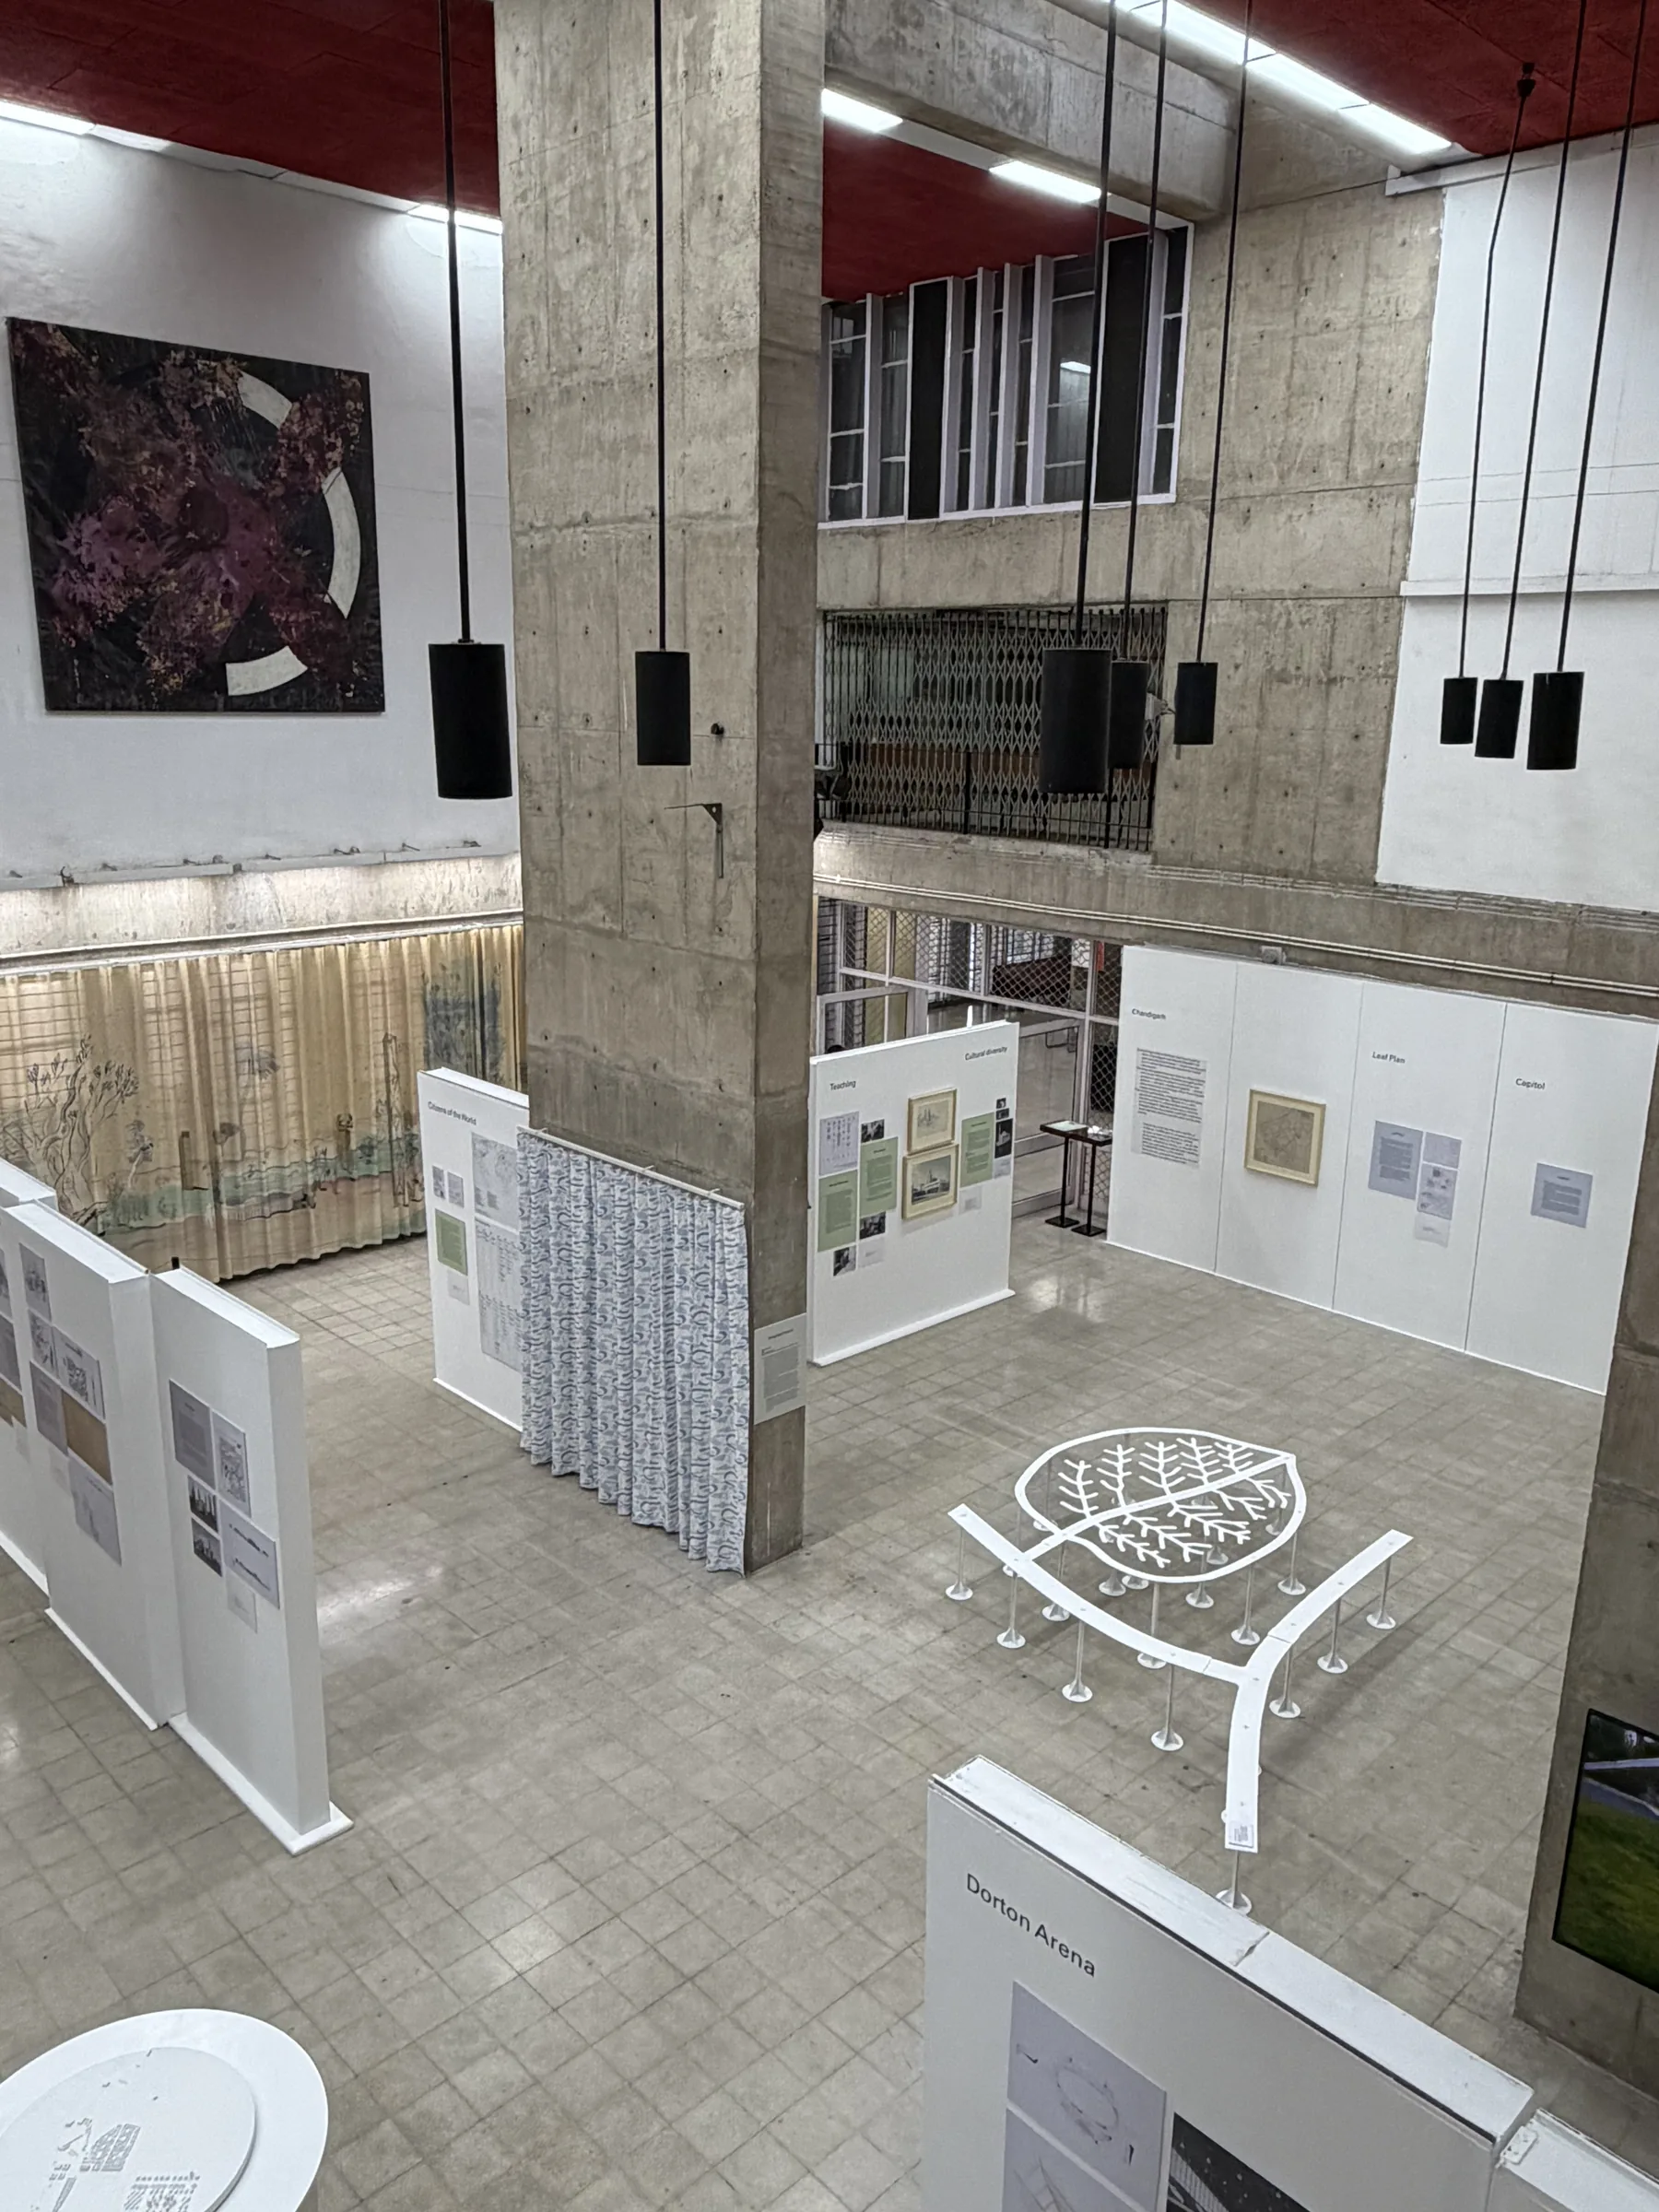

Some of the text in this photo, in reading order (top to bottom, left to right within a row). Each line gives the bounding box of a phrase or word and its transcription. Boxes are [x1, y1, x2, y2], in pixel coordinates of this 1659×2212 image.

[1132, 1008, 1167, 1020] Chandigarh
[964, 1046, 1008, 1061] Cultural diversity
[1371, 1051, 1406, 1064] Leaf Plan
[830, 1080, 856, 1091] Teaching
[1515, 1077, 1546, 1090] Capitol
[428, 1100, 447, 1114] Citizens
[461, 1113, 477, 1125] World
[967, 1872, 1096, 1978] Dorton Arena
